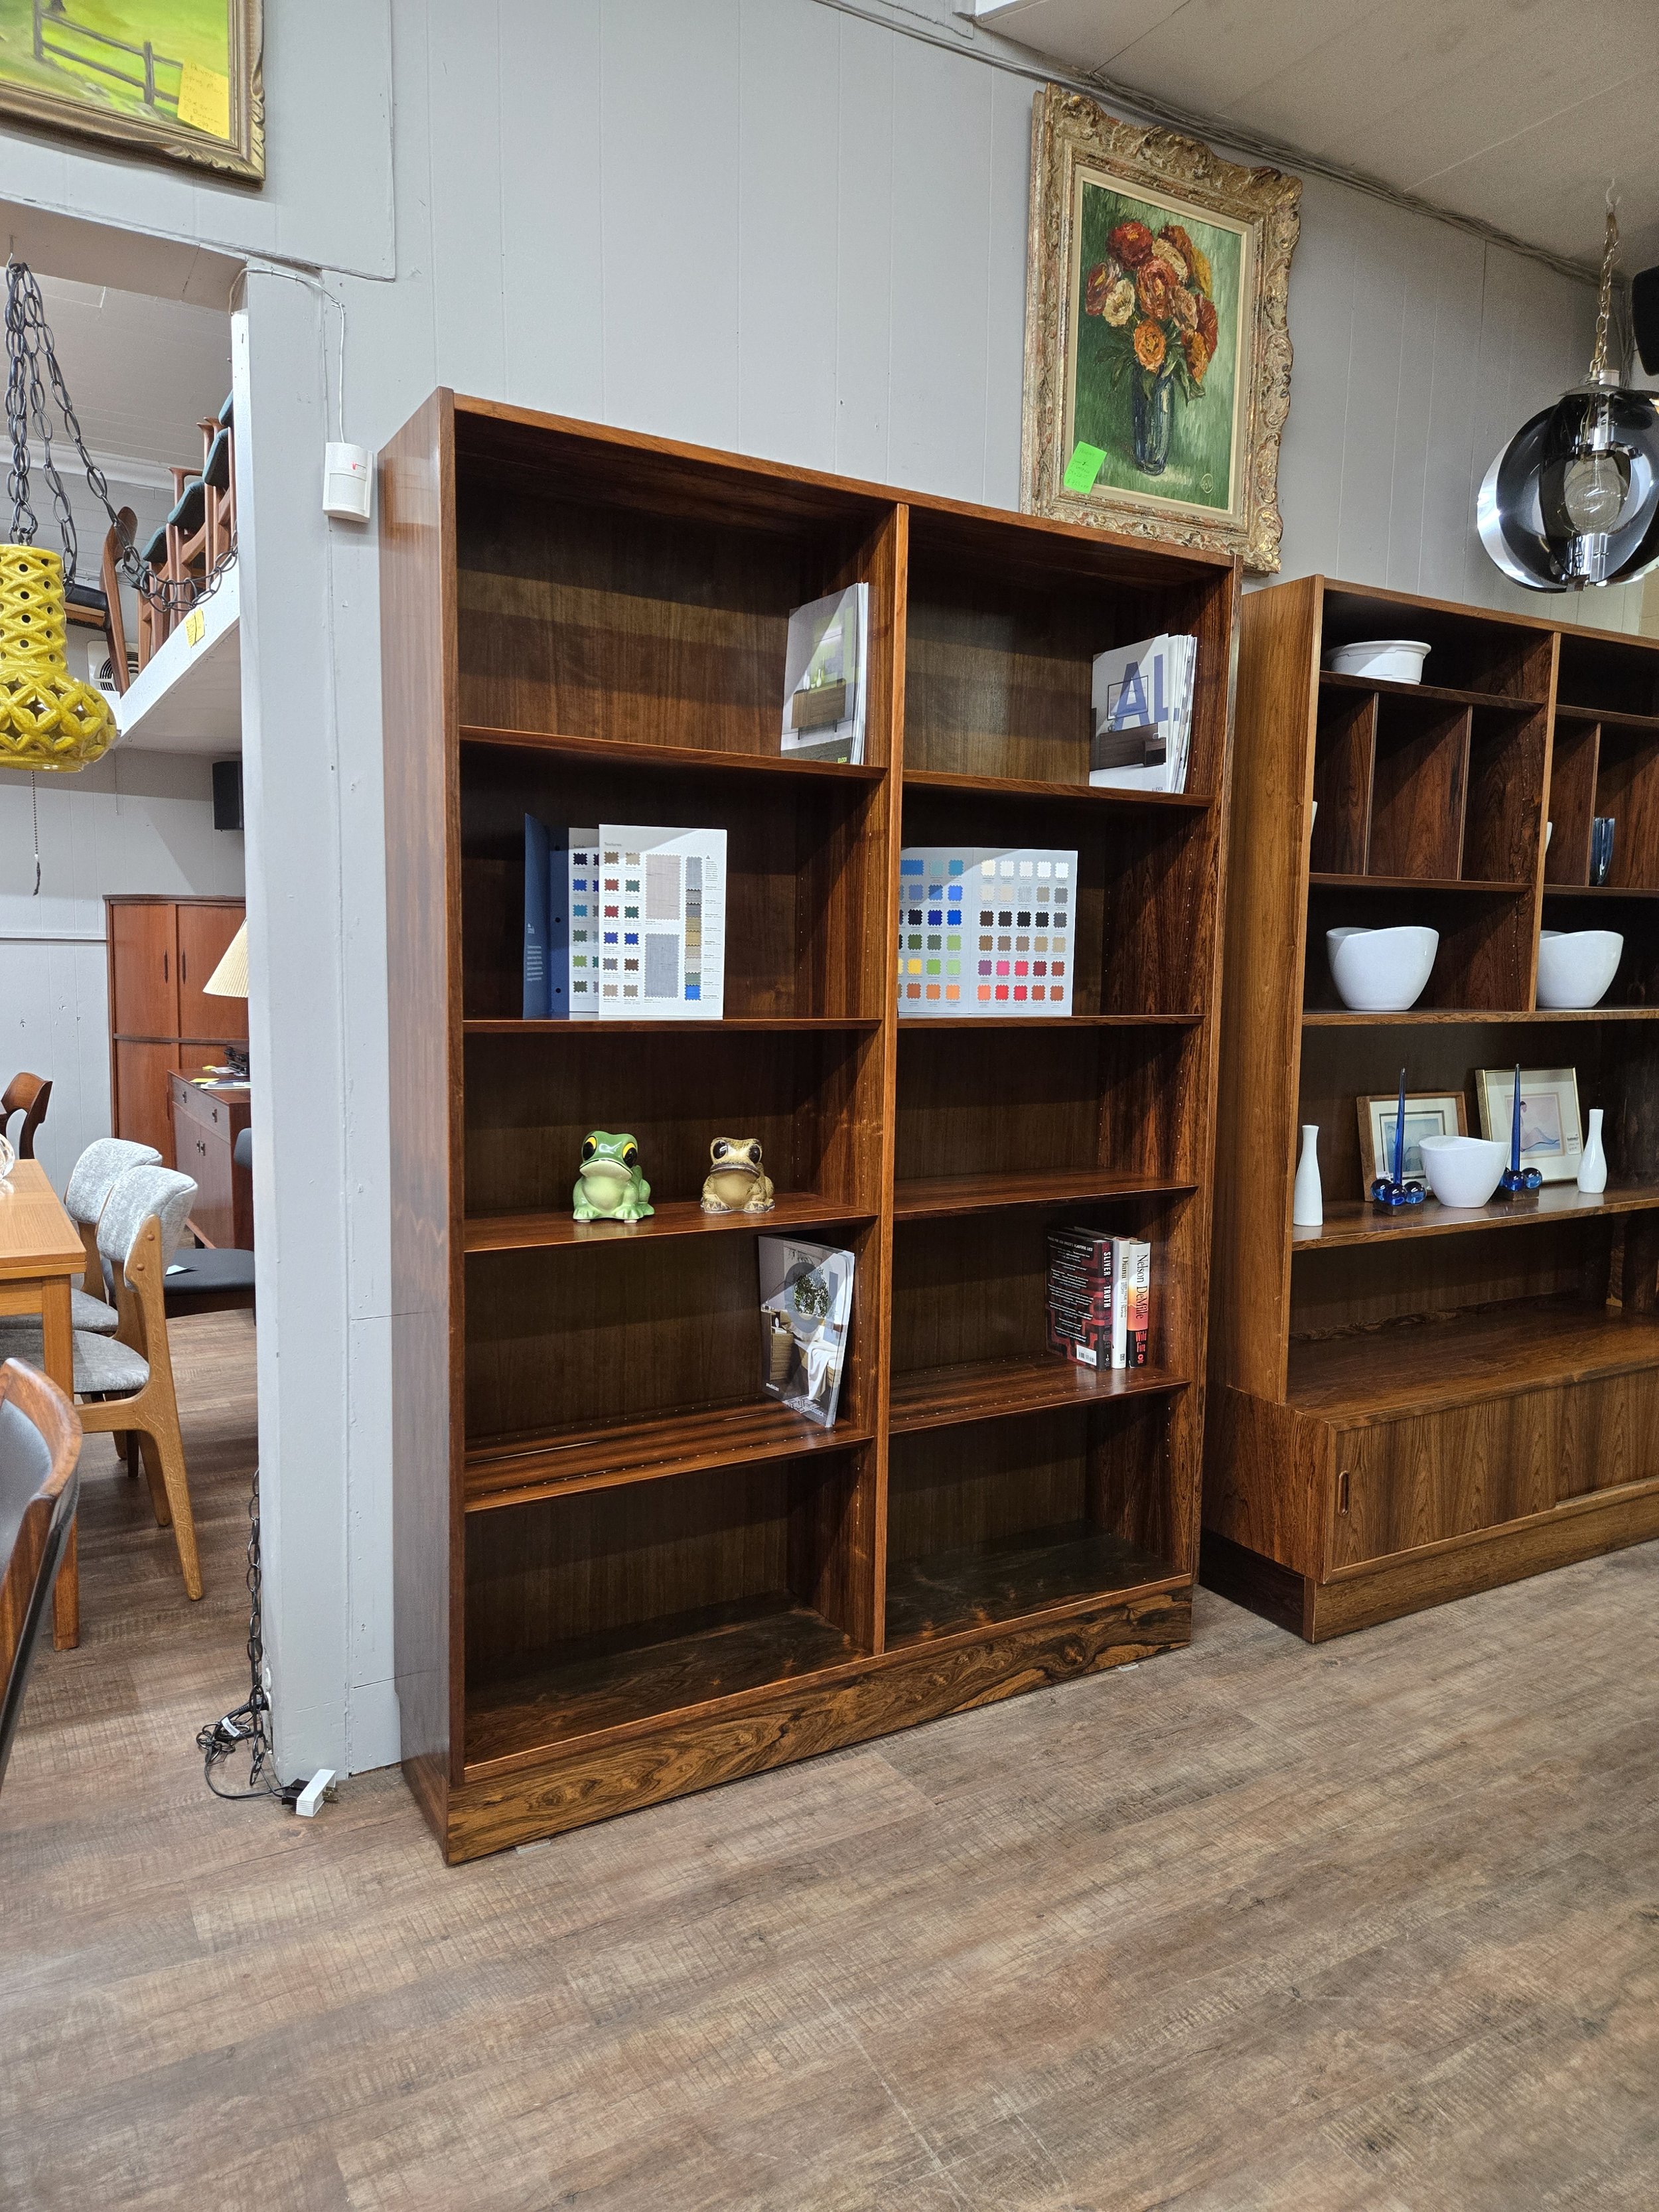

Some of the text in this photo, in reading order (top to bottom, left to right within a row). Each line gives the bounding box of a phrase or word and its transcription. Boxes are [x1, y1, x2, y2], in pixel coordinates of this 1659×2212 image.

[1103, 1251, 1112, 1276] SLIVER
[1103, 1285, 1112, 1308] TRUTH
[1135, 1253, 1149, 1319] Nelson DeMille
[1135, 1330, 1147, 1342] Wild
[1136, 1342, 1146, 1353] Fire
